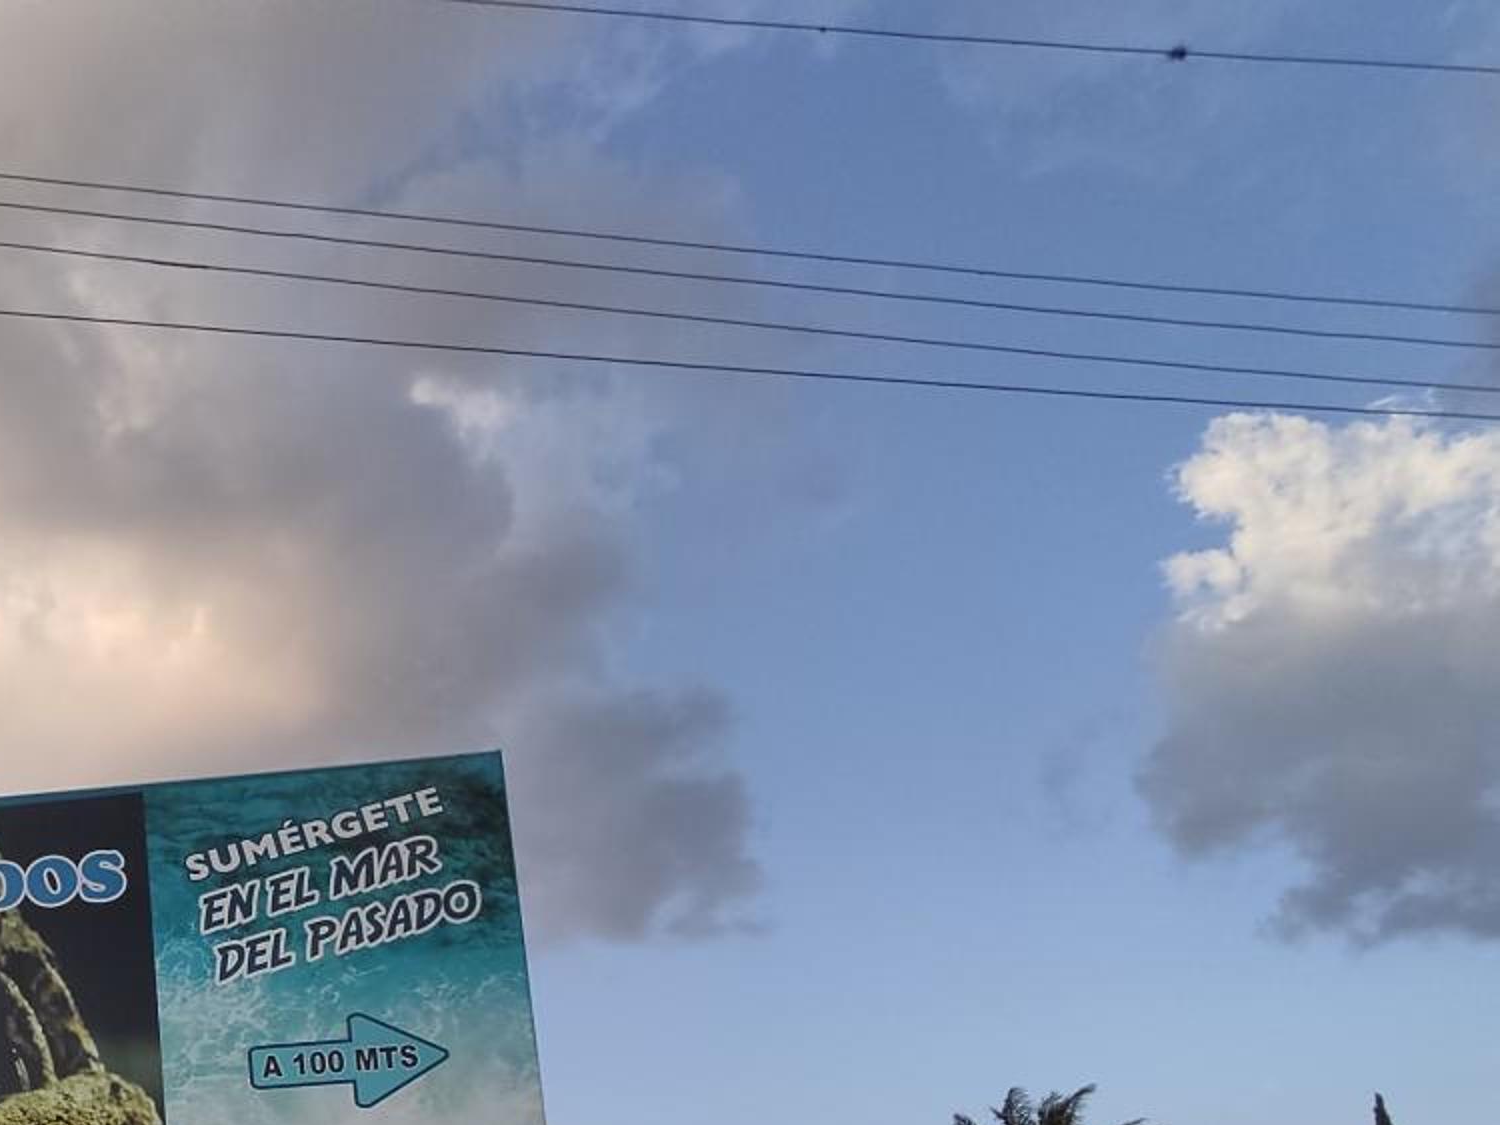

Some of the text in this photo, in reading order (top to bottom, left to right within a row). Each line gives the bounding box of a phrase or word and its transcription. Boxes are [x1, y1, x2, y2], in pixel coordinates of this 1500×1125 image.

[185, 786, 444, 881] SUMÉRGETE
[201, 835, 442, 934] EN EL MAR
[215, 880, 483, 984] DEL PASADO
[263, 1045, 418, 1077] A 100 MTS
